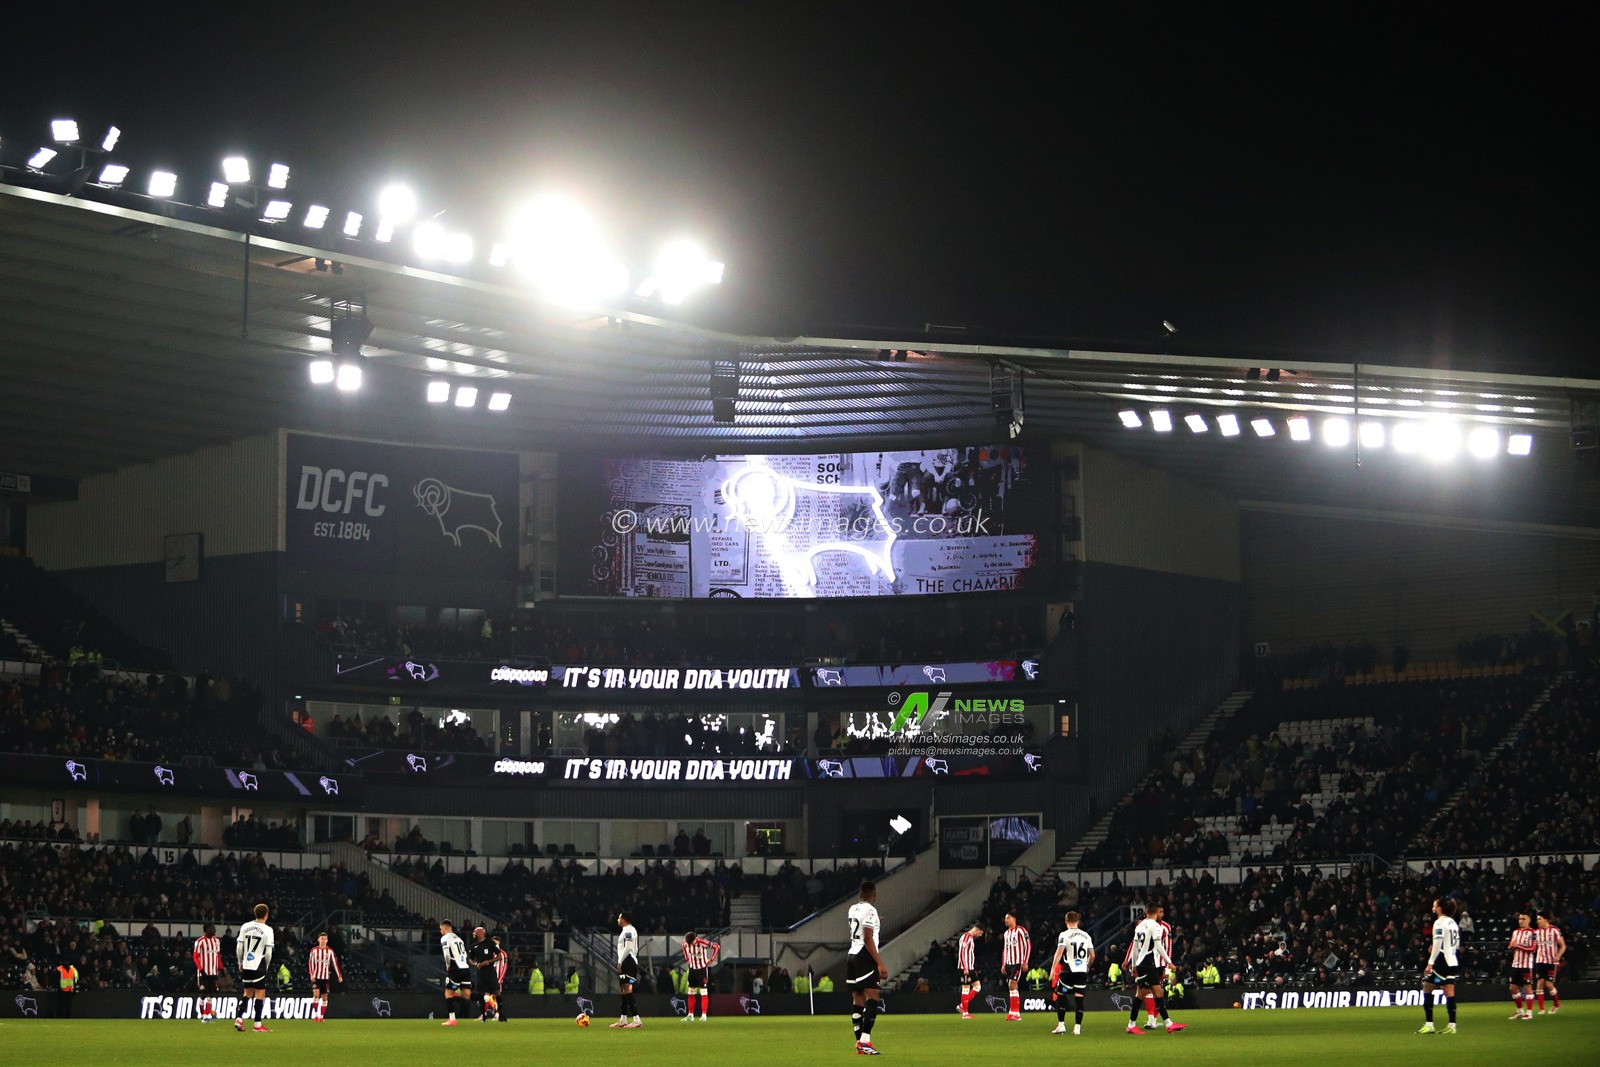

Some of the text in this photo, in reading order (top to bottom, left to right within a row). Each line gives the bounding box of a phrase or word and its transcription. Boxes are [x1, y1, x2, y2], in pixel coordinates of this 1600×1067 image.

[296, 464, 389, 517] DCFC
[916, 578, 944, 593] THE
[563, 666, 600, 688] IT'S
[604, 668, 624, 689] IN
[628, 668, 679, 690] YOUR
[684, 669, 723, 689] DNA
[727, 668, 791, 690] YOUTH
[564, 757, 601, 780] IT'S
[606, 759, 626, 780] IN
[631, 760, 681, 780] YOUR
[686, 760, 724, 780] DNA
[729, 760, 792, 780] YOUTH
[164, 850, 175, 864] 15
[245, 934, 262, 953] 17
[1070, 941, 1087, 960] 16
[140, 995, 174, 1019] IT'S
[175, 996, 193, 1019] IN
[1242, 990, 1277, 1010] IT'S
